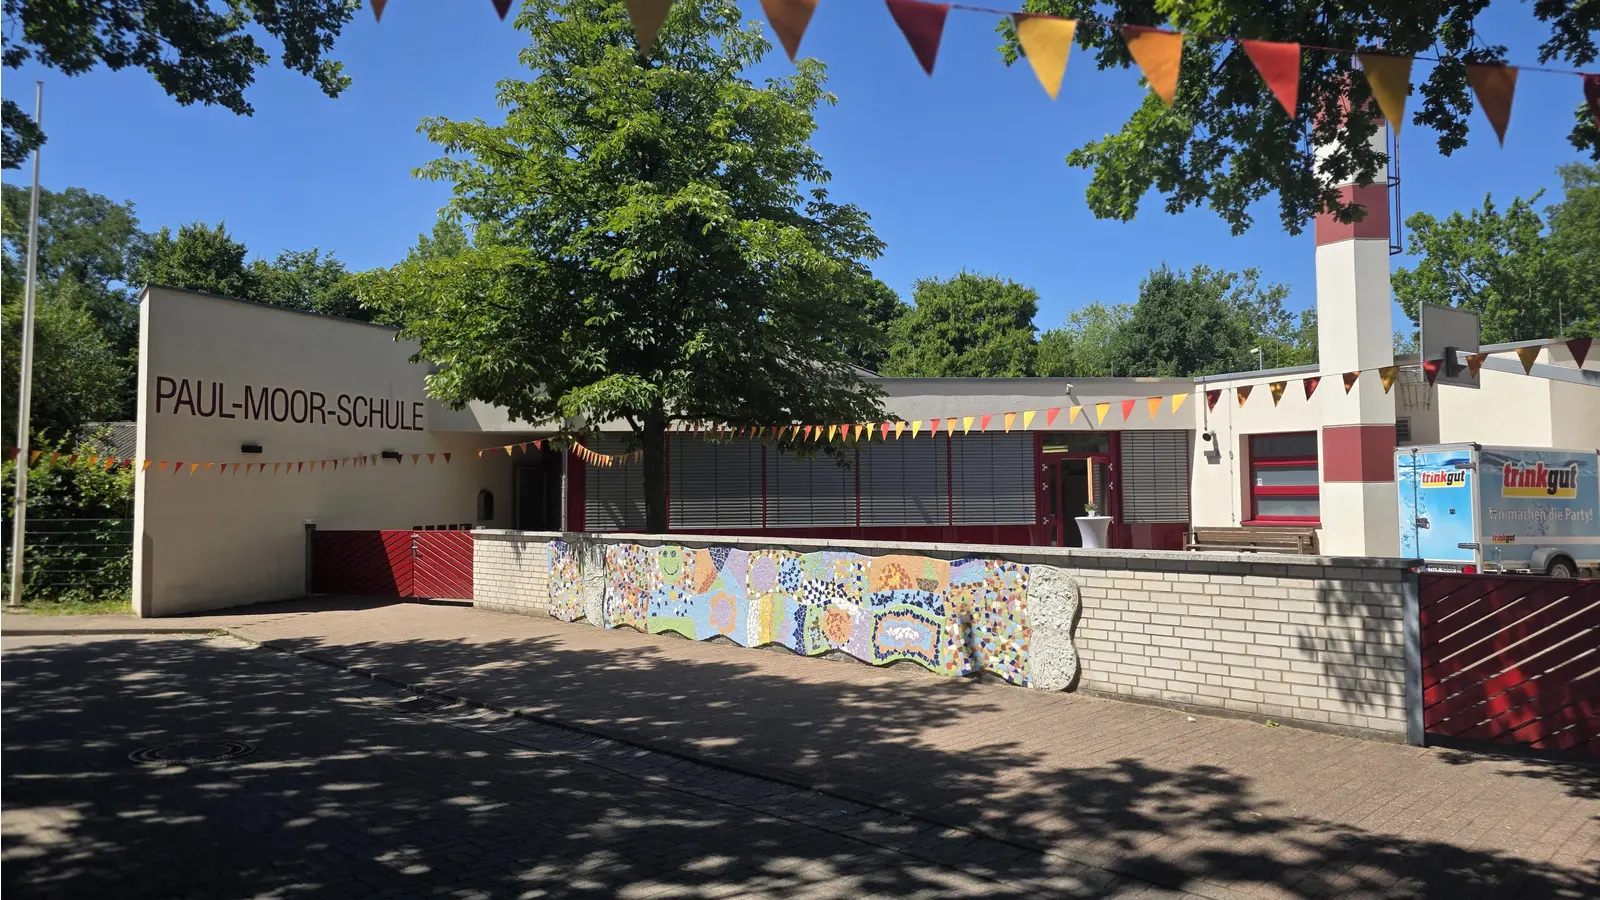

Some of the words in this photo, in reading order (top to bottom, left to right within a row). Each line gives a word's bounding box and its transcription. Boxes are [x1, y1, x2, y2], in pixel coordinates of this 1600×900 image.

[156, 376, 424, 431] PAUL-MOOR-SCHULE
[1422, 471, 1465, 485] trinkgut
[1504, 462, 1577, 495] trinkgut
[1489, 507, 1504, 520] Wir
[1508, 508, 1545, 520] machen
[1548, 508, 1563, 521] die
[1565, 508, 1593, 524] Party!
